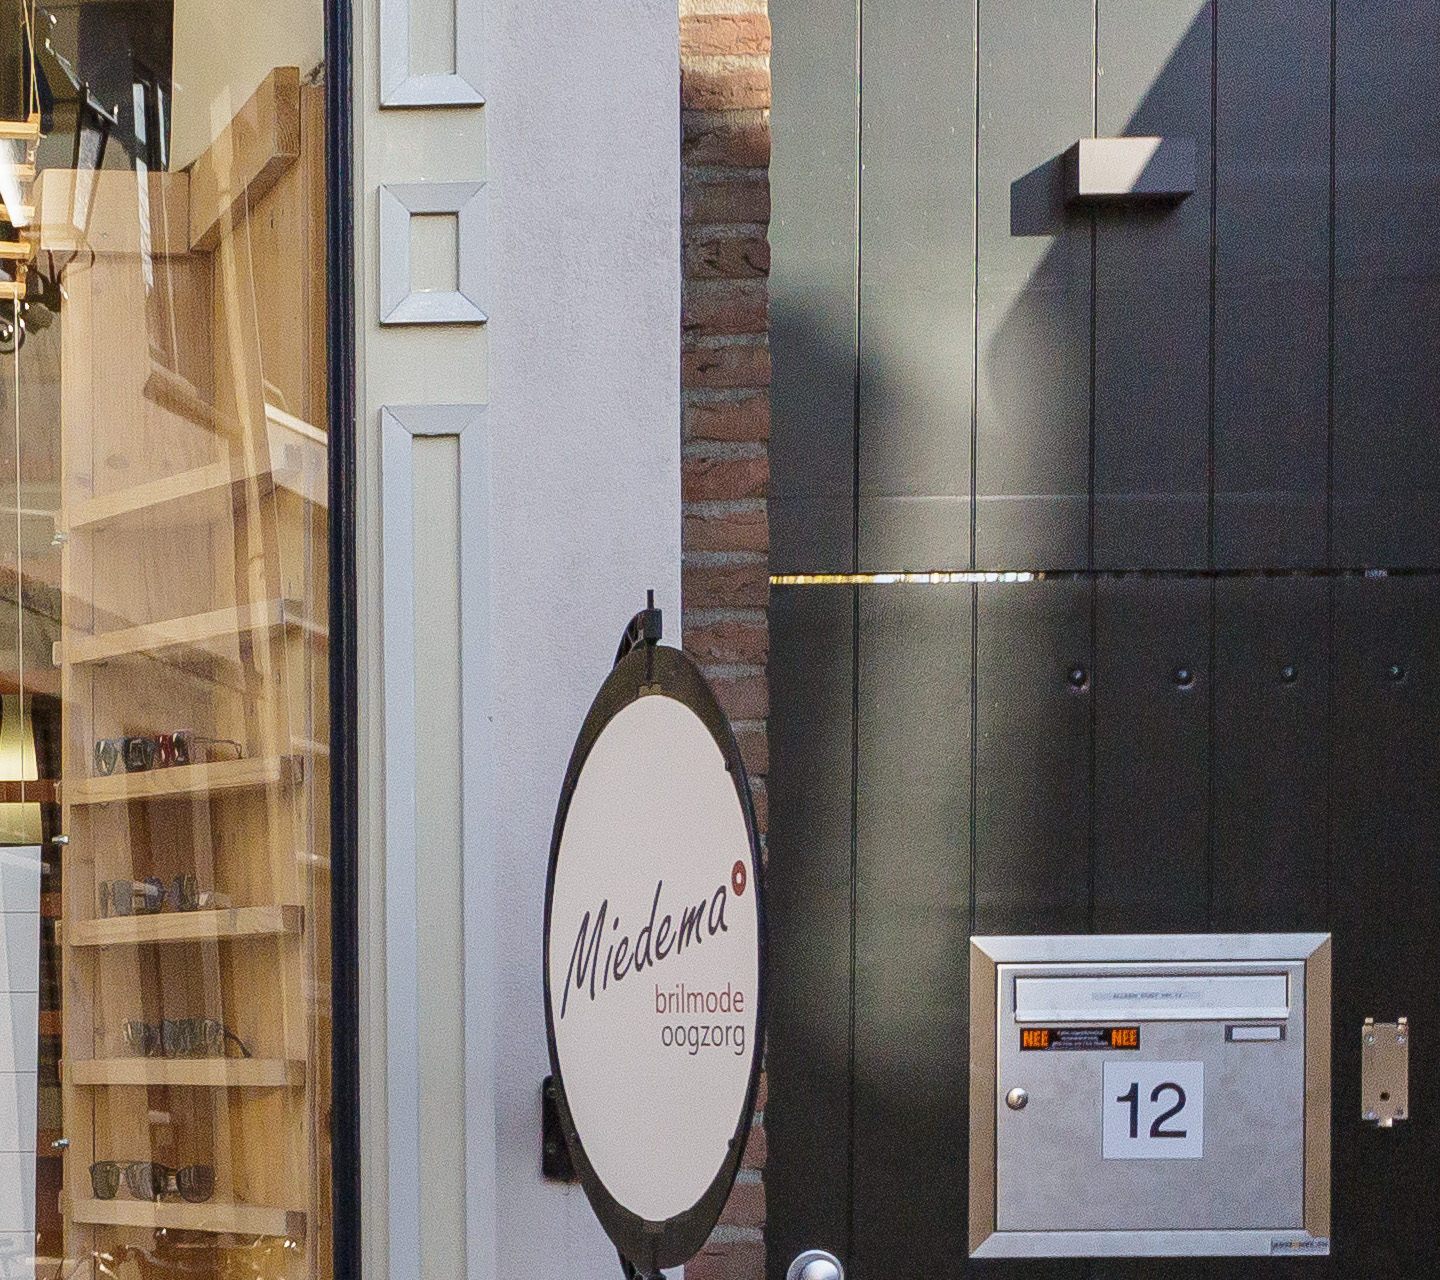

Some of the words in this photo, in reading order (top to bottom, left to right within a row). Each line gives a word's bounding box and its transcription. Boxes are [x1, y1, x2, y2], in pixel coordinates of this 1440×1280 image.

[561, 880, 728, 1019] Miedema
[655, 982, 744, 1014] brilmode
[661, 1024, 746, 1056] oogzorg
[1023, 1030, 1049, 1047] NEE
[1111, 1029, 1137, 1046] NEE
[1116, 1082, 1187, 1139] 12
